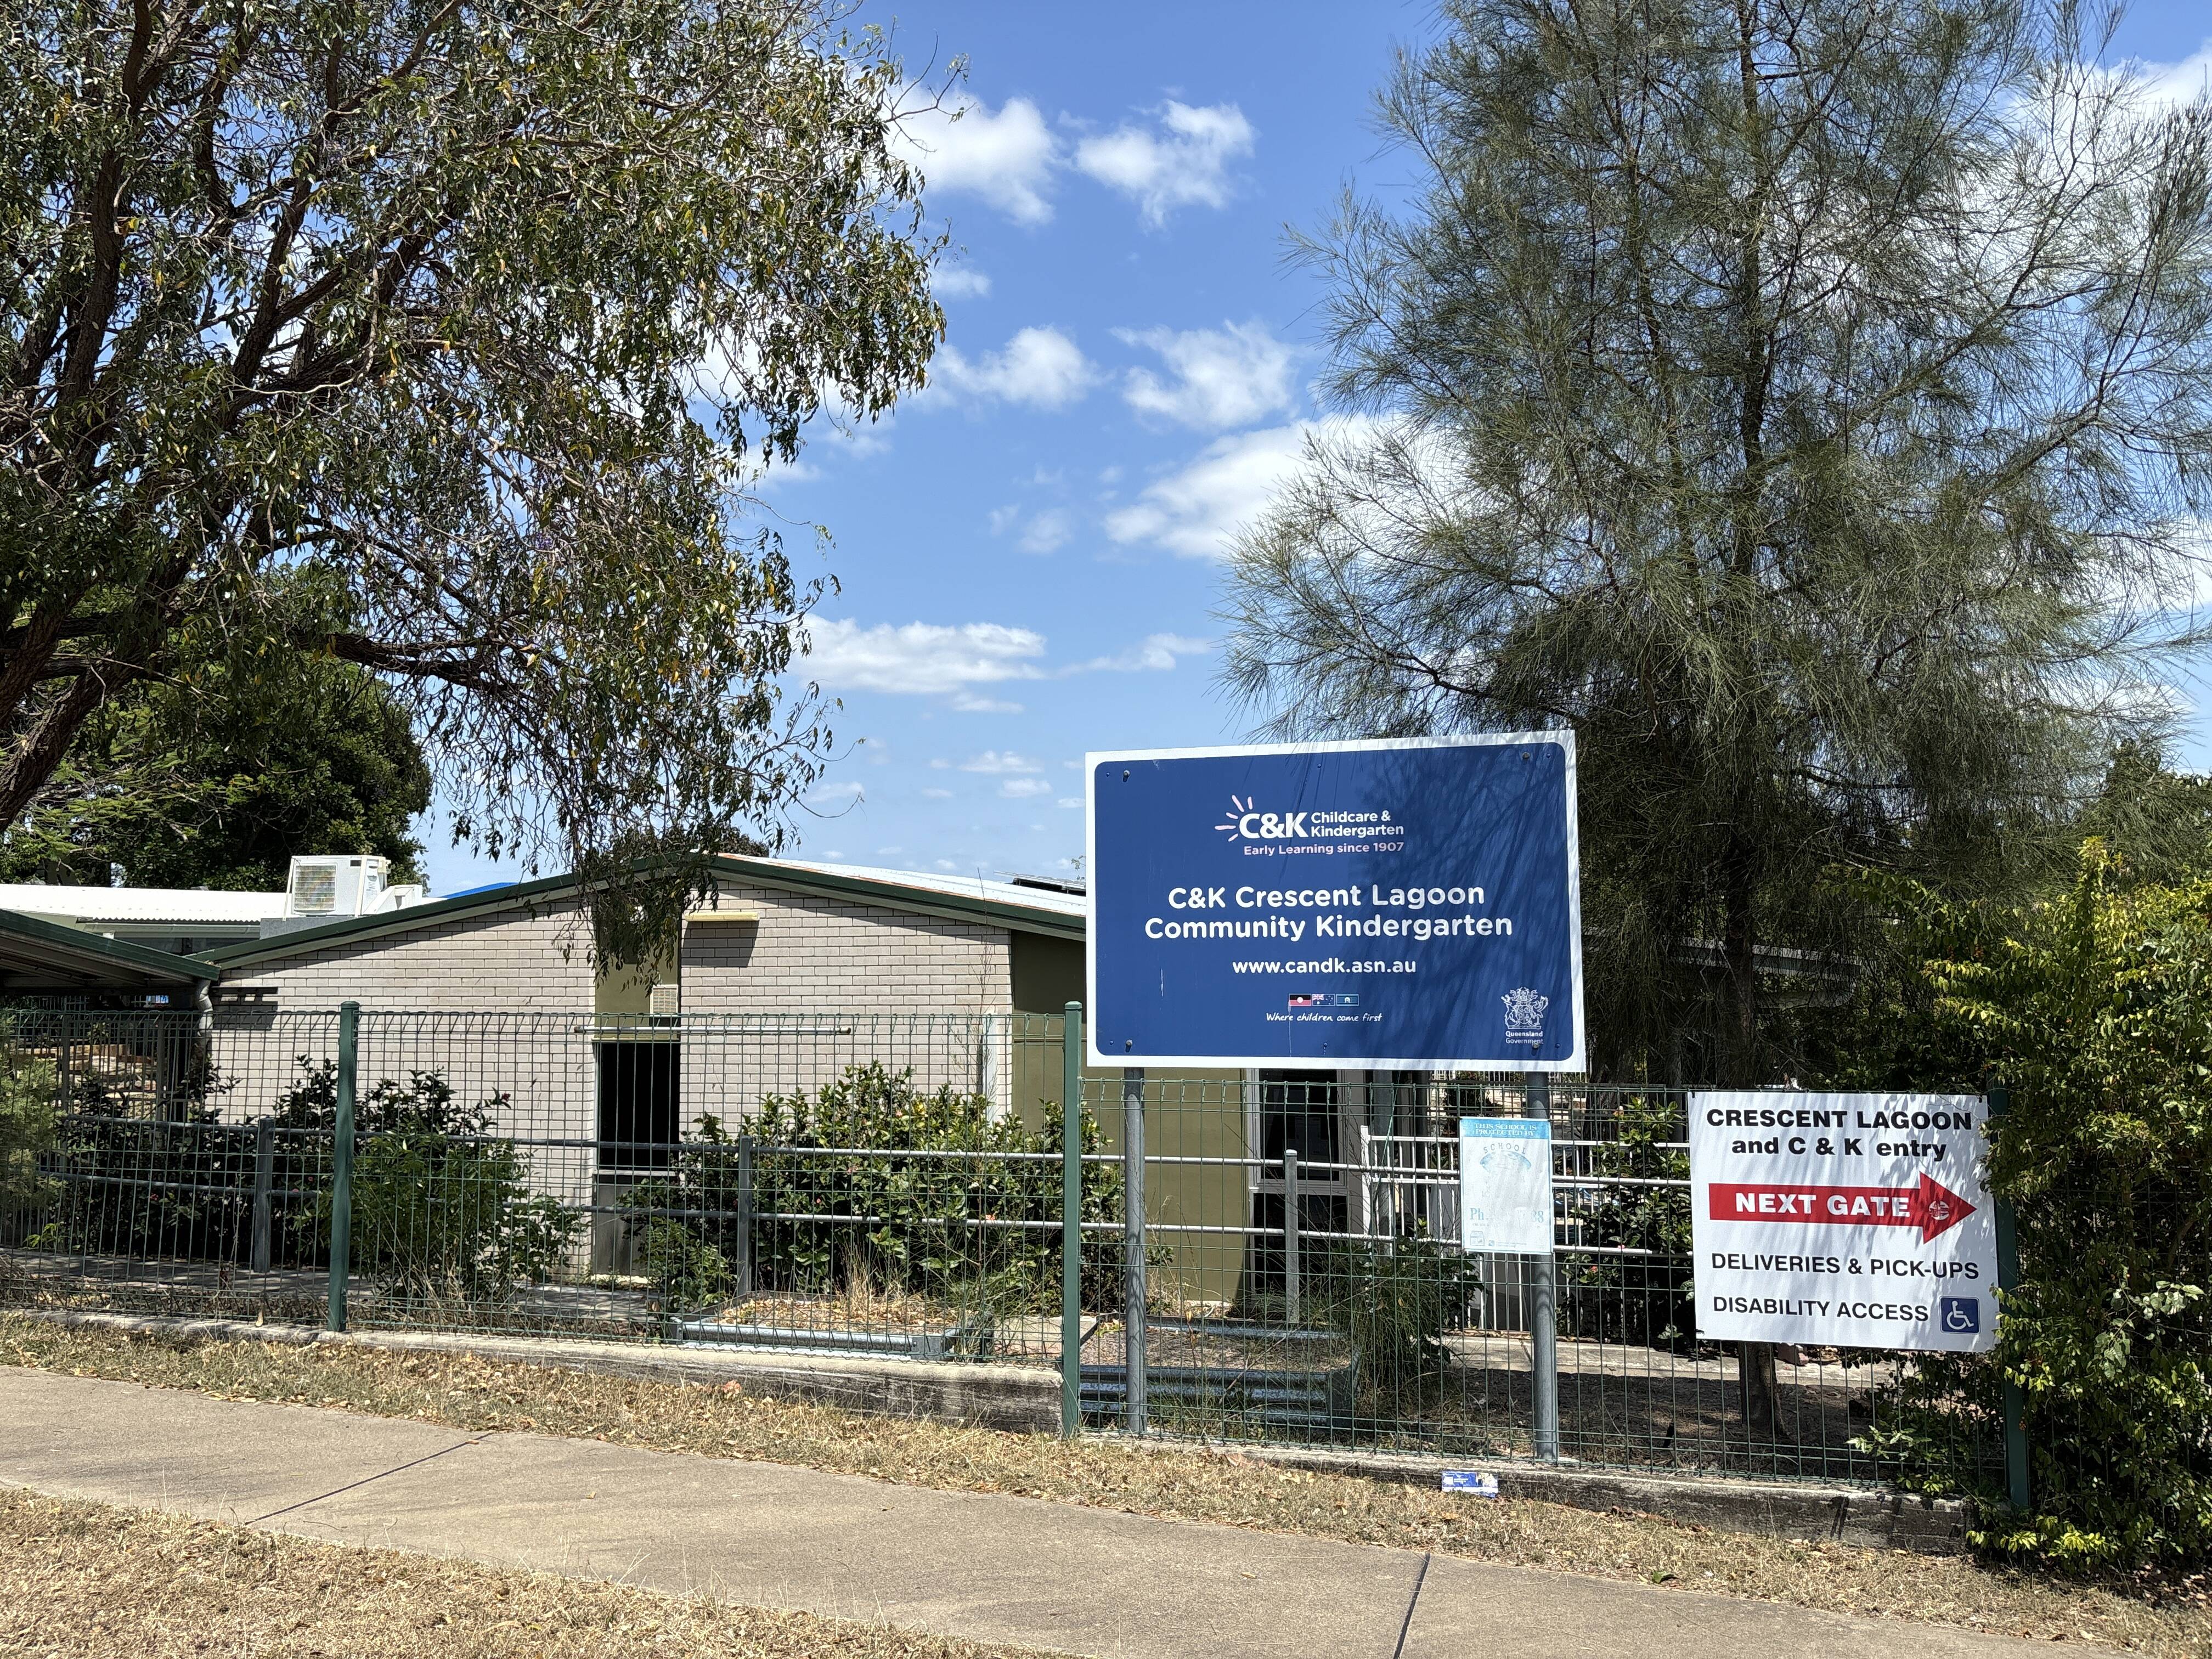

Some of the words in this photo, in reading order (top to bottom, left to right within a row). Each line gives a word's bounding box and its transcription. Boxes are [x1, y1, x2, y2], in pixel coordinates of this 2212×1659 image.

[1239, 812, 1309, 839] C&K
[1311, 811, 1378, 823] Childcare
[1381, 810, 1391, 822] &
[1311, 824, 1404, 838] Kindergarten
[1244, 845, 1276, 856] Early
[1278, 843, 1334, 855] Learning
[1337, 842, 1370, 853] since
[1373, 842, 1404, 852] 1907
[1168, 887, 1226, 909] C&K
[1235, 885, 1362, 908] Crescent
[1372, 884, 1485, 910] Lagoon
[1144, 915, 1306, 942] Community
[1316, 914, 1513, 941] Kindergarten
[1232, 957, 1417, 974] www.candk.asn.au
[1266, 1012, 1294, 1022] Where
[1296, 1013, 1333, 1022] children
[1362, 1013, 1383, 1022] first
[1707, 1109, 1848, 1128] CRESCENT
[1857, 1111, 1972, 1130] LAGOON
[1483, 1142, 1526, 1155] SCHOOL
[1731, 1137, 1779, 1154] and
[1788, 1137, 1807, 1154] C
[1815, 1138, 1835, 1155] &
[1844, 1138, 1864, 1156] K
[1876, 1140, 1947, 1162] entry
[1735, 1193, 1817, 1214] NEXT
[1827, 1195, 1911, 1217] GATE
[1712, 1253, 1841, 1273] DELIVERIES
[1848, 1258, 1863, 1275] &
[1871, 1260, 1980, 1279] PICK-UPS
[1713, 1296, 1830, 1316] DISABILITY
[1837, 1302, 1929, 1322] ACCESS
